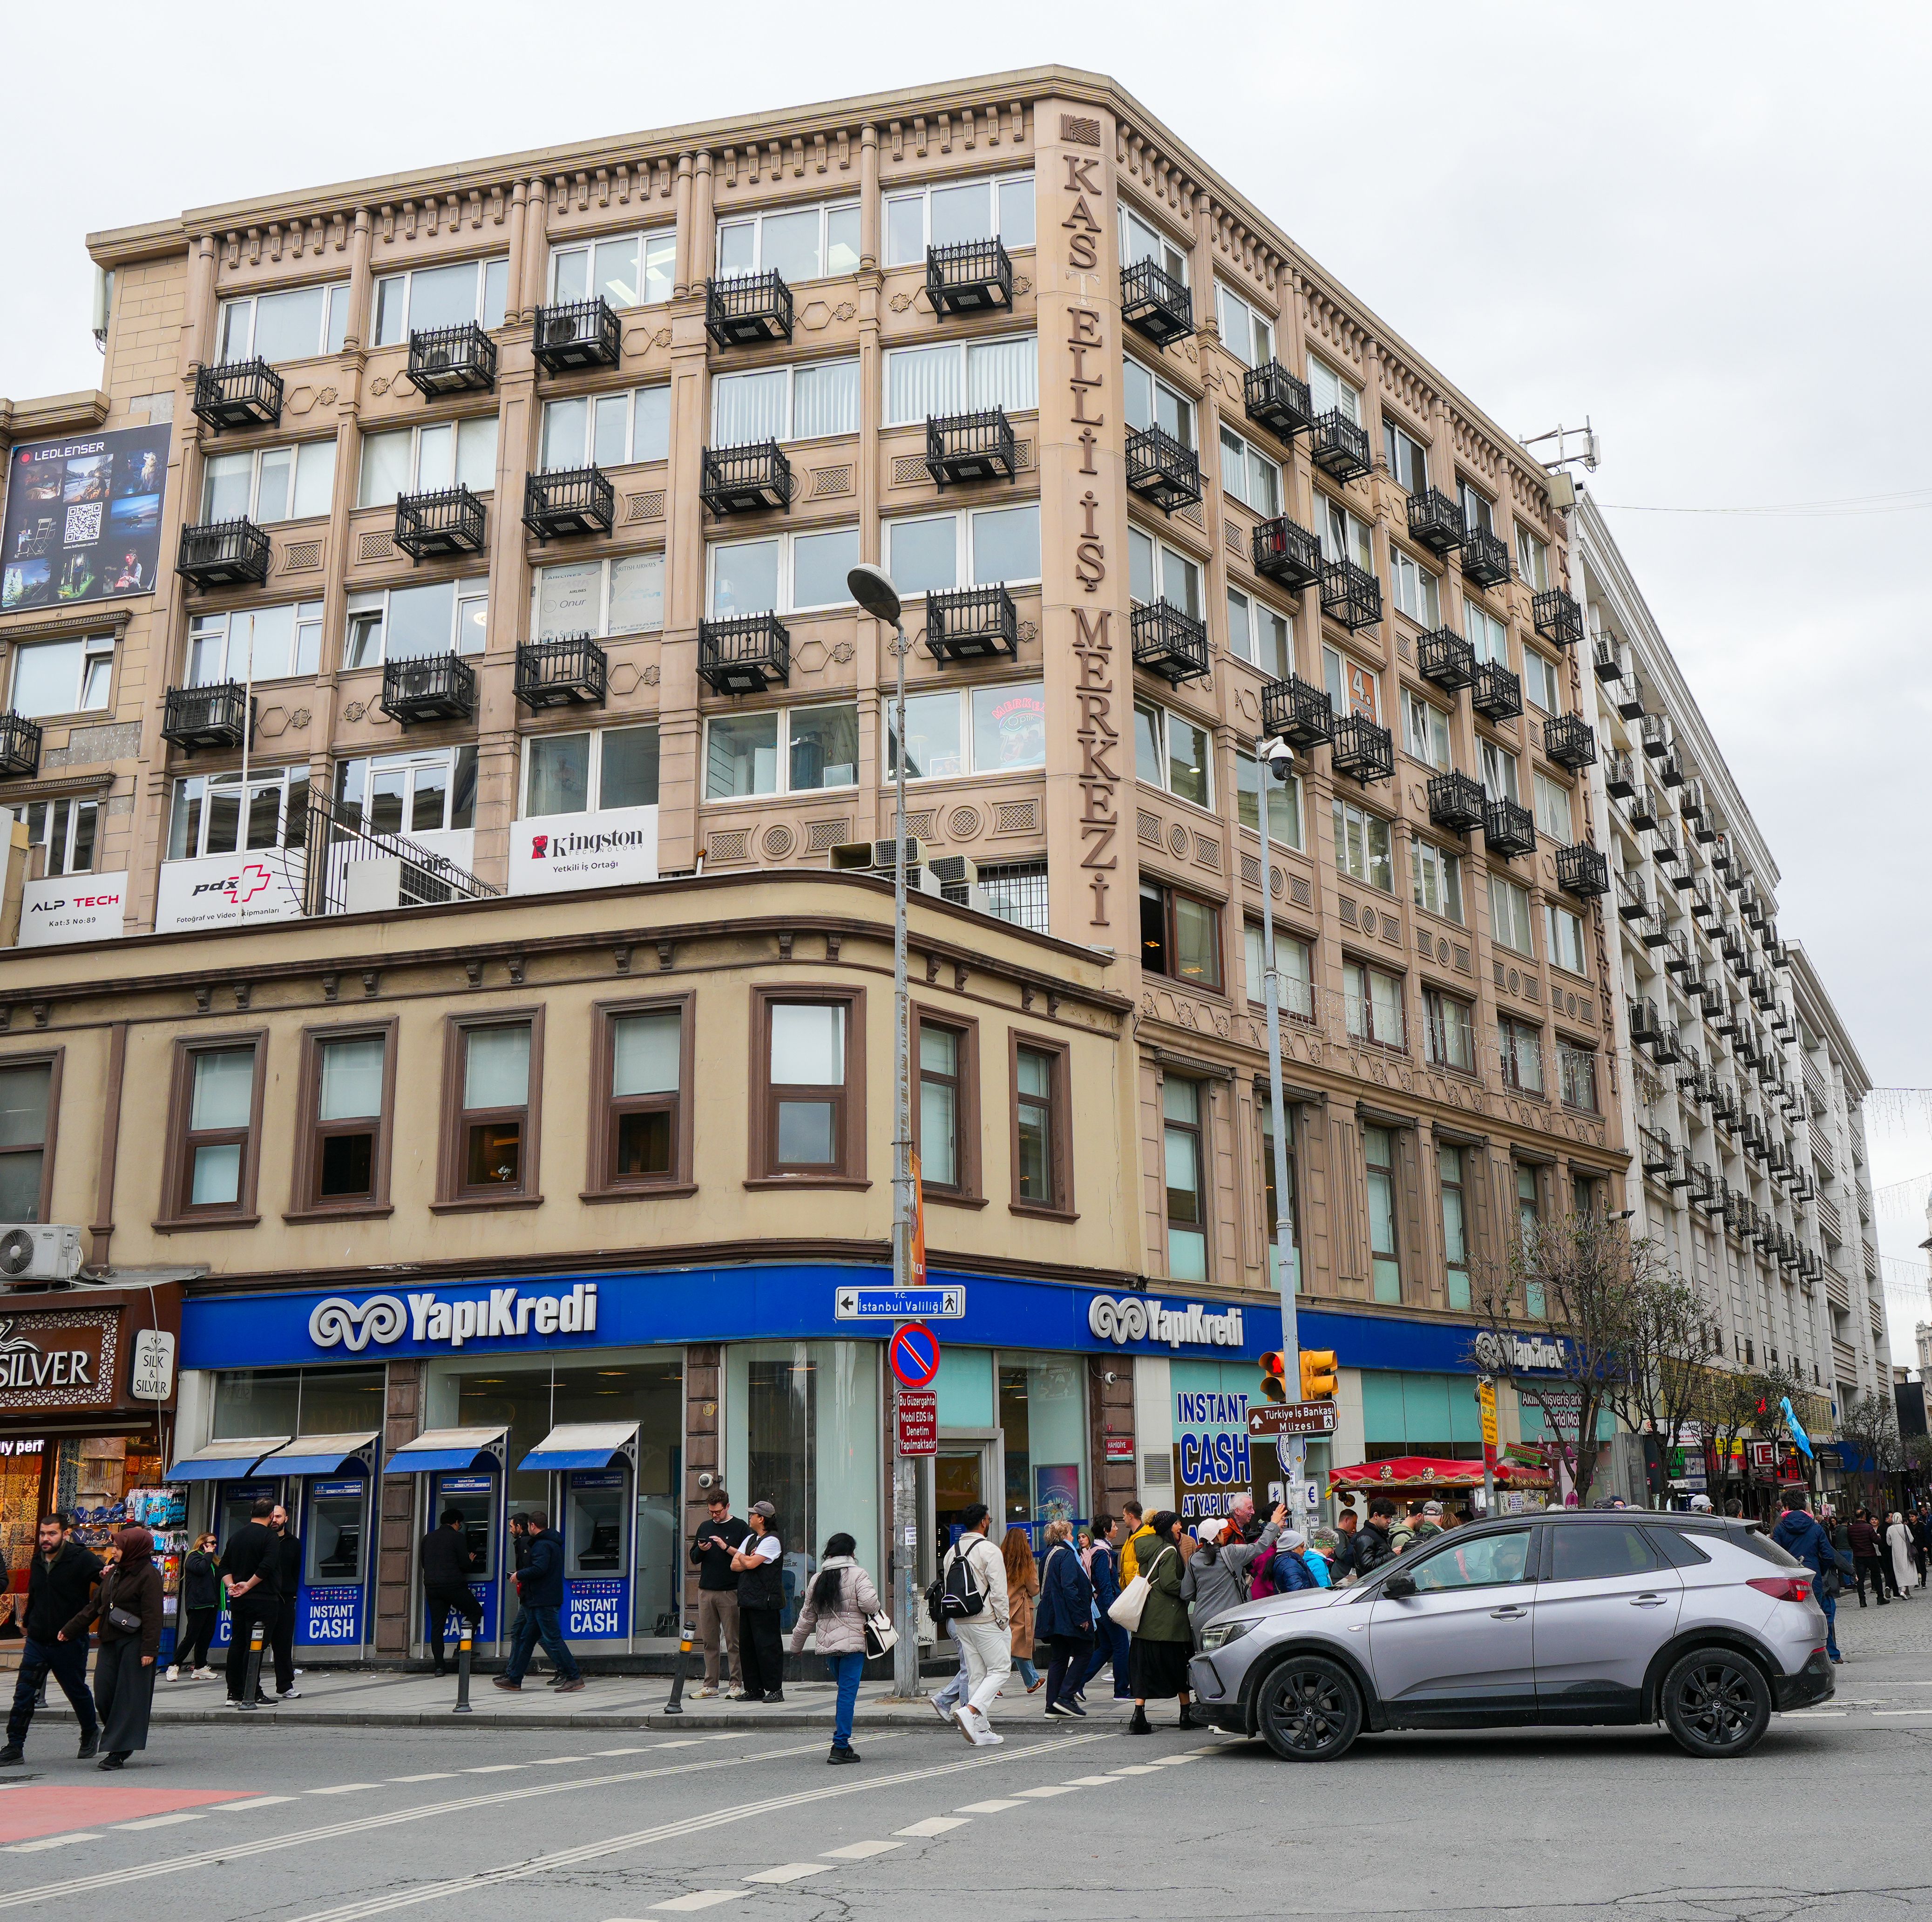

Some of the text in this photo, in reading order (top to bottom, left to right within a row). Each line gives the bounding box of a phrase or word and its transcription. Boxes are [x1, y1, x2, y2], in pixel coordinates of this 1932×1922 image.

[34, 441, 105, 461] LEDLENSER
[1075, 490, 1105, 591] İŞ
[616, 564, 635, 573] BRITISH
[560, 599, 586, 608] Onur
[1008, 714, 1035, 726] Optik
[1071, 607, 1121, 926] MERKEZİ
[551, 829, 644, 858] Kingston
[569, 843, 644, 856] TECHNOLOGY
[553, 860, 618, 873] Yetkili İş Ortağı
[191, 880, 239, 897] pdx
[30, 894, 119, 913] ALP TECH
[49, 916, 96, 927] Kat:3 No:89
[176, 914, 205, 923] Fotoğraf
[238, 907, 279, 918] kipmanları
[858, 1299, 942, 1314] İstanbul Valiliği
[407, 1283, 598, 1347] YapıKredi
[1144, 1299, 1244, 1348] YapıKredi
[0, 1351, 94, 1387] SILVER
[143, 1355, 164, 1368] SILK
[149, 1370, 156, 1378] &
[136, 1379, 167, 1394] SILVER
[899, 1395, 935, 1408] Bu Güzergahta
[1176, 1391, 1248, 1425] INSTANT
[901, 1412, 915, 1422] Mobil
[915, 1412, 926, 1422] EDS
[1264, 1405, 1335, 1423] Türkiye İş Bankası
[1544, 1412, 1566, 1426] Wrld
[906, 1425, 929, 1436] Denetim
[1279, 1421, 1315, 1432] Müzesi
[899, 1439, 936, 1453] Yapılmaktadır
[1107, 1441, 1126, 1449] HAMİDİYE
[1180, 1432, 1253, 1487] CASH
[1182, 1494, 1196, 1518] AT
[1197, 1493, 1221, 1517] YAPI
[310, 1604, 355, 1618] INSTANT
[570, 1598, 618, 1612] INSTANT
[309, 1618, 354, 1639] CASH
[570, 1612, 618, 1633] CASH
